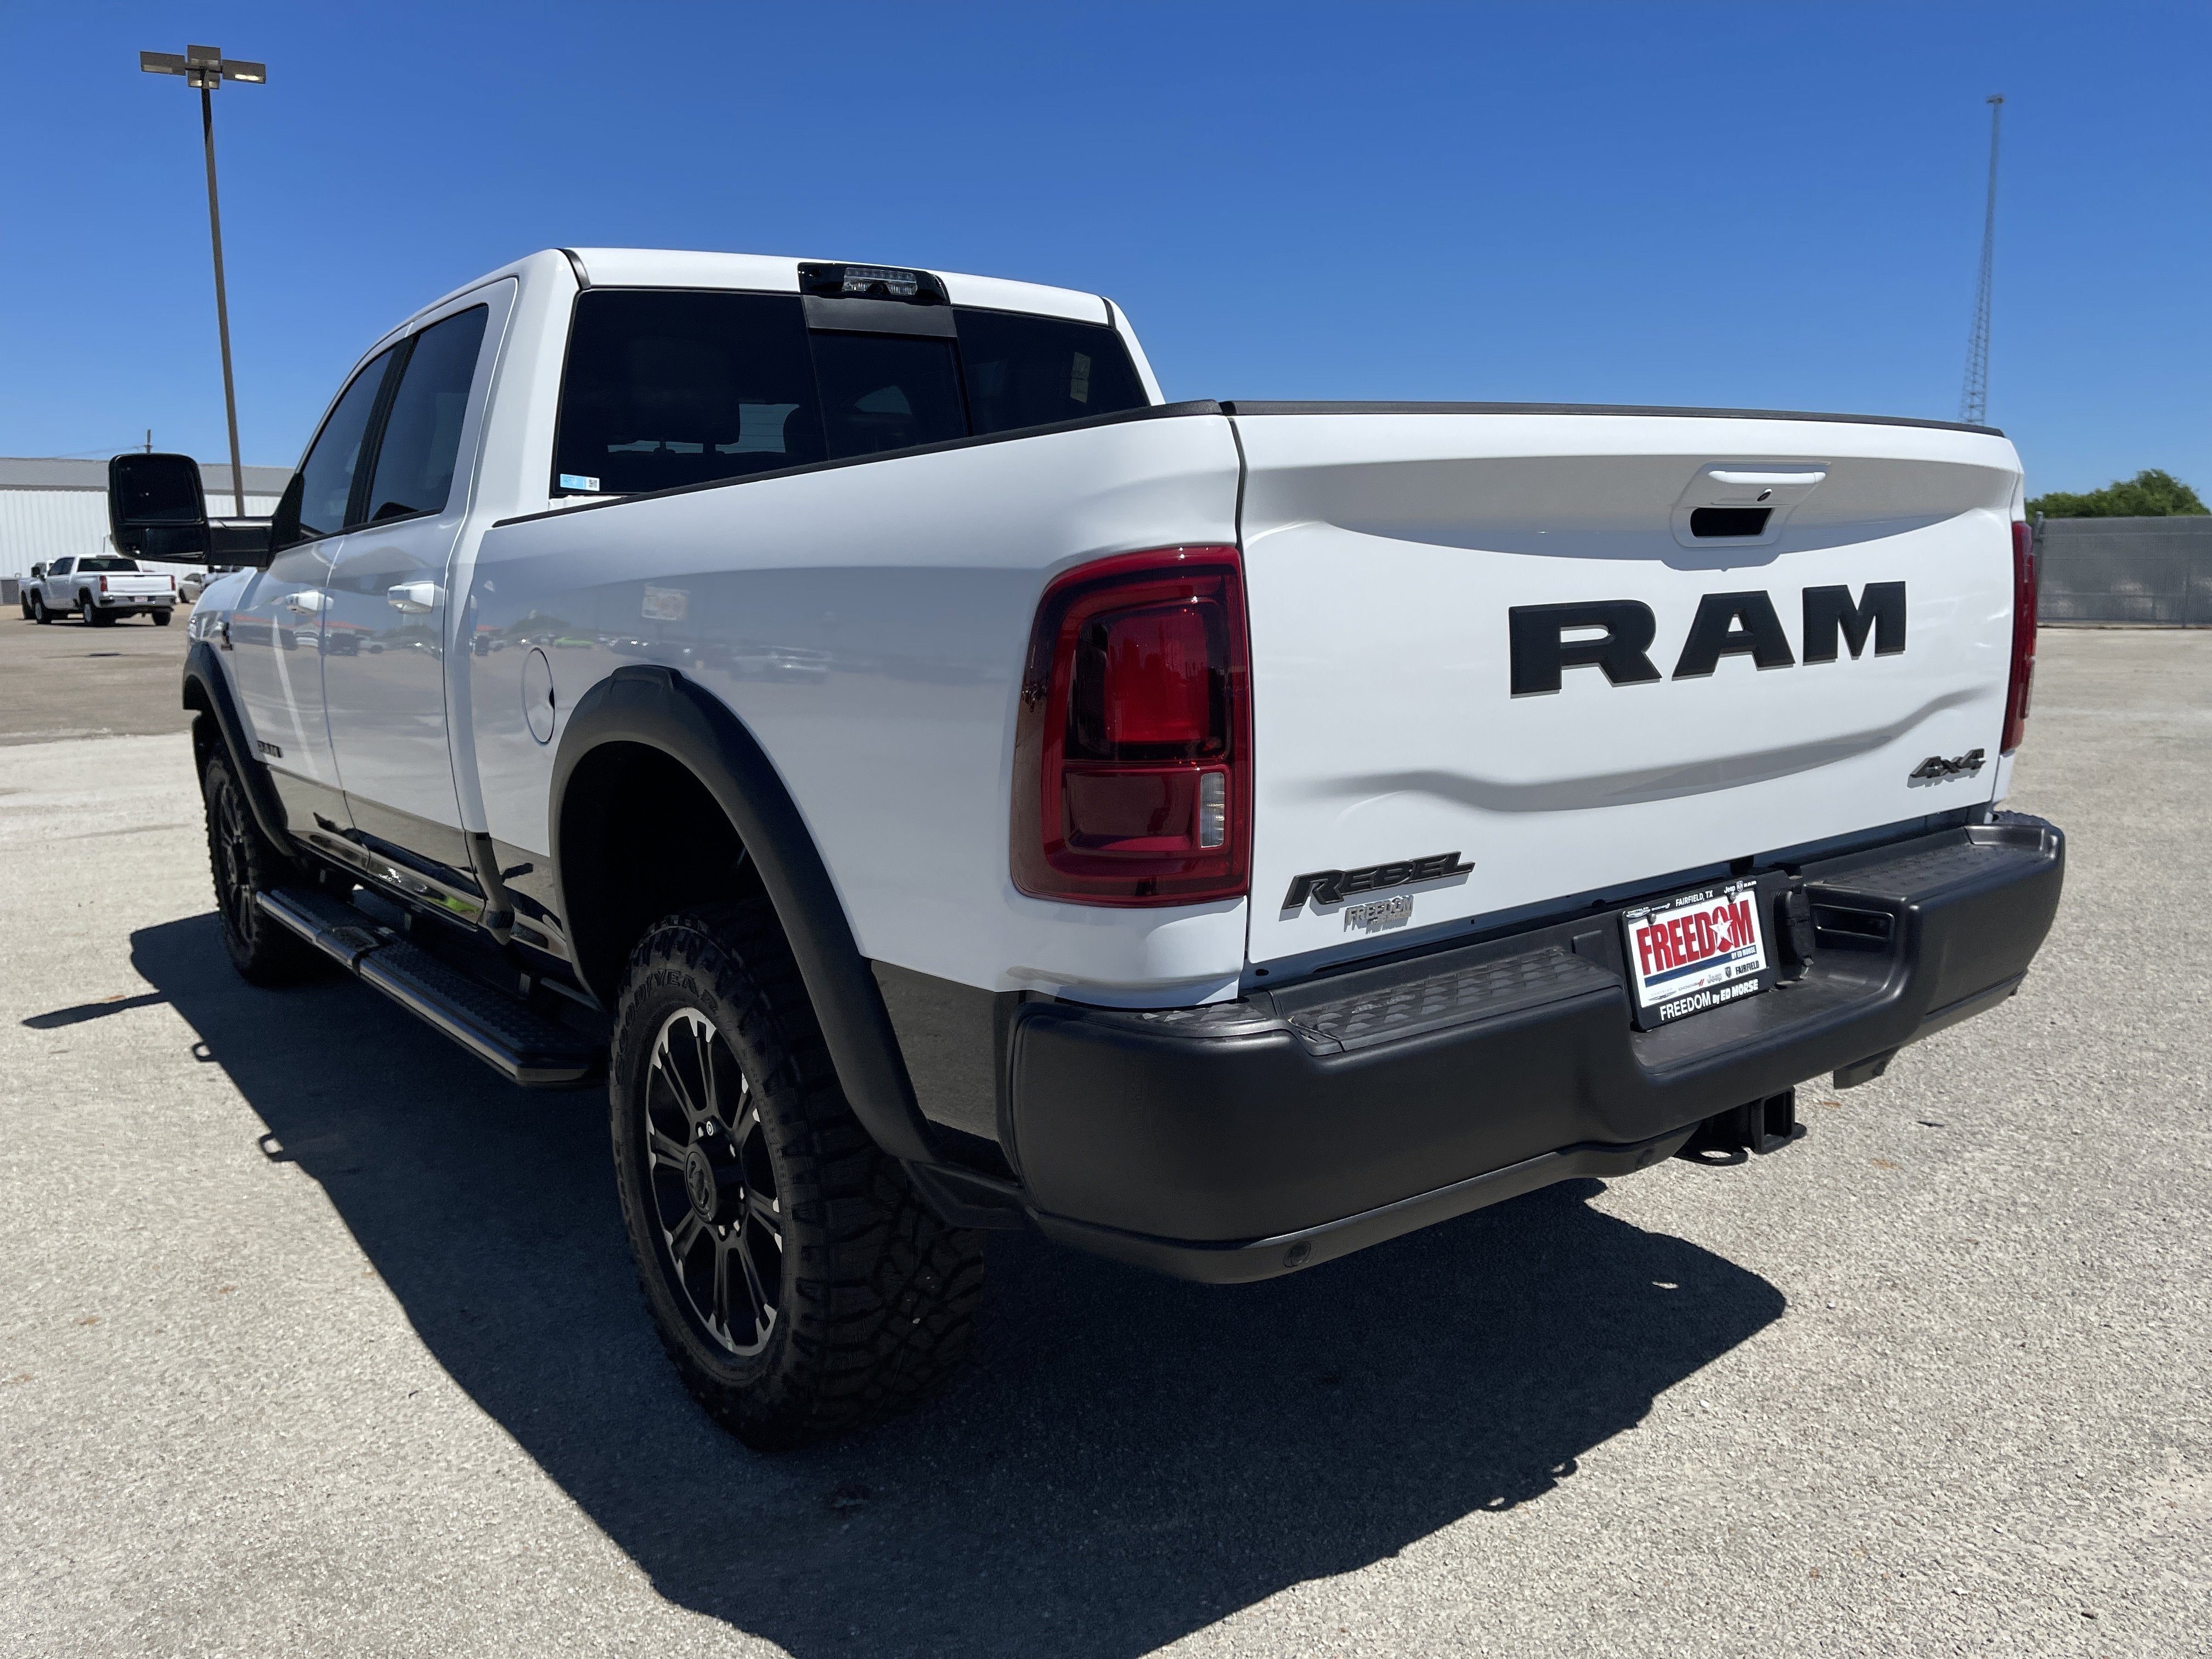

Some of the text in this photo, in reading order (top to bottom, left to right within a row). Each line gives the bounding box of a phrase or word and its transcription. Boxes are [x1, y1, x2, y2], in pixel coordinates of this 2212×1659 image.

[1508, 581, 1906, 696] RAM
[1910, 748, 1986, 780] 4x4
[1281, 850, 1476, 910] REBEL
[1724, 885, 1735, 894] Jeep
[1346, 895, 1414, 926] FREEDOM
[1675, 890, 1713, 907] FAIRFIELD, TX
[1636, 899, 1756, 976] FREEDOM
[1707, 973, 1722, 984] Jeep
[1735, 960, 1759, 975] FAIRFIELD
[1660, 991, 1711, 1021] FREEDOM
[1720, 988, 1731, 1001] ED
[1731, 979, 1759, 997] MORSE
